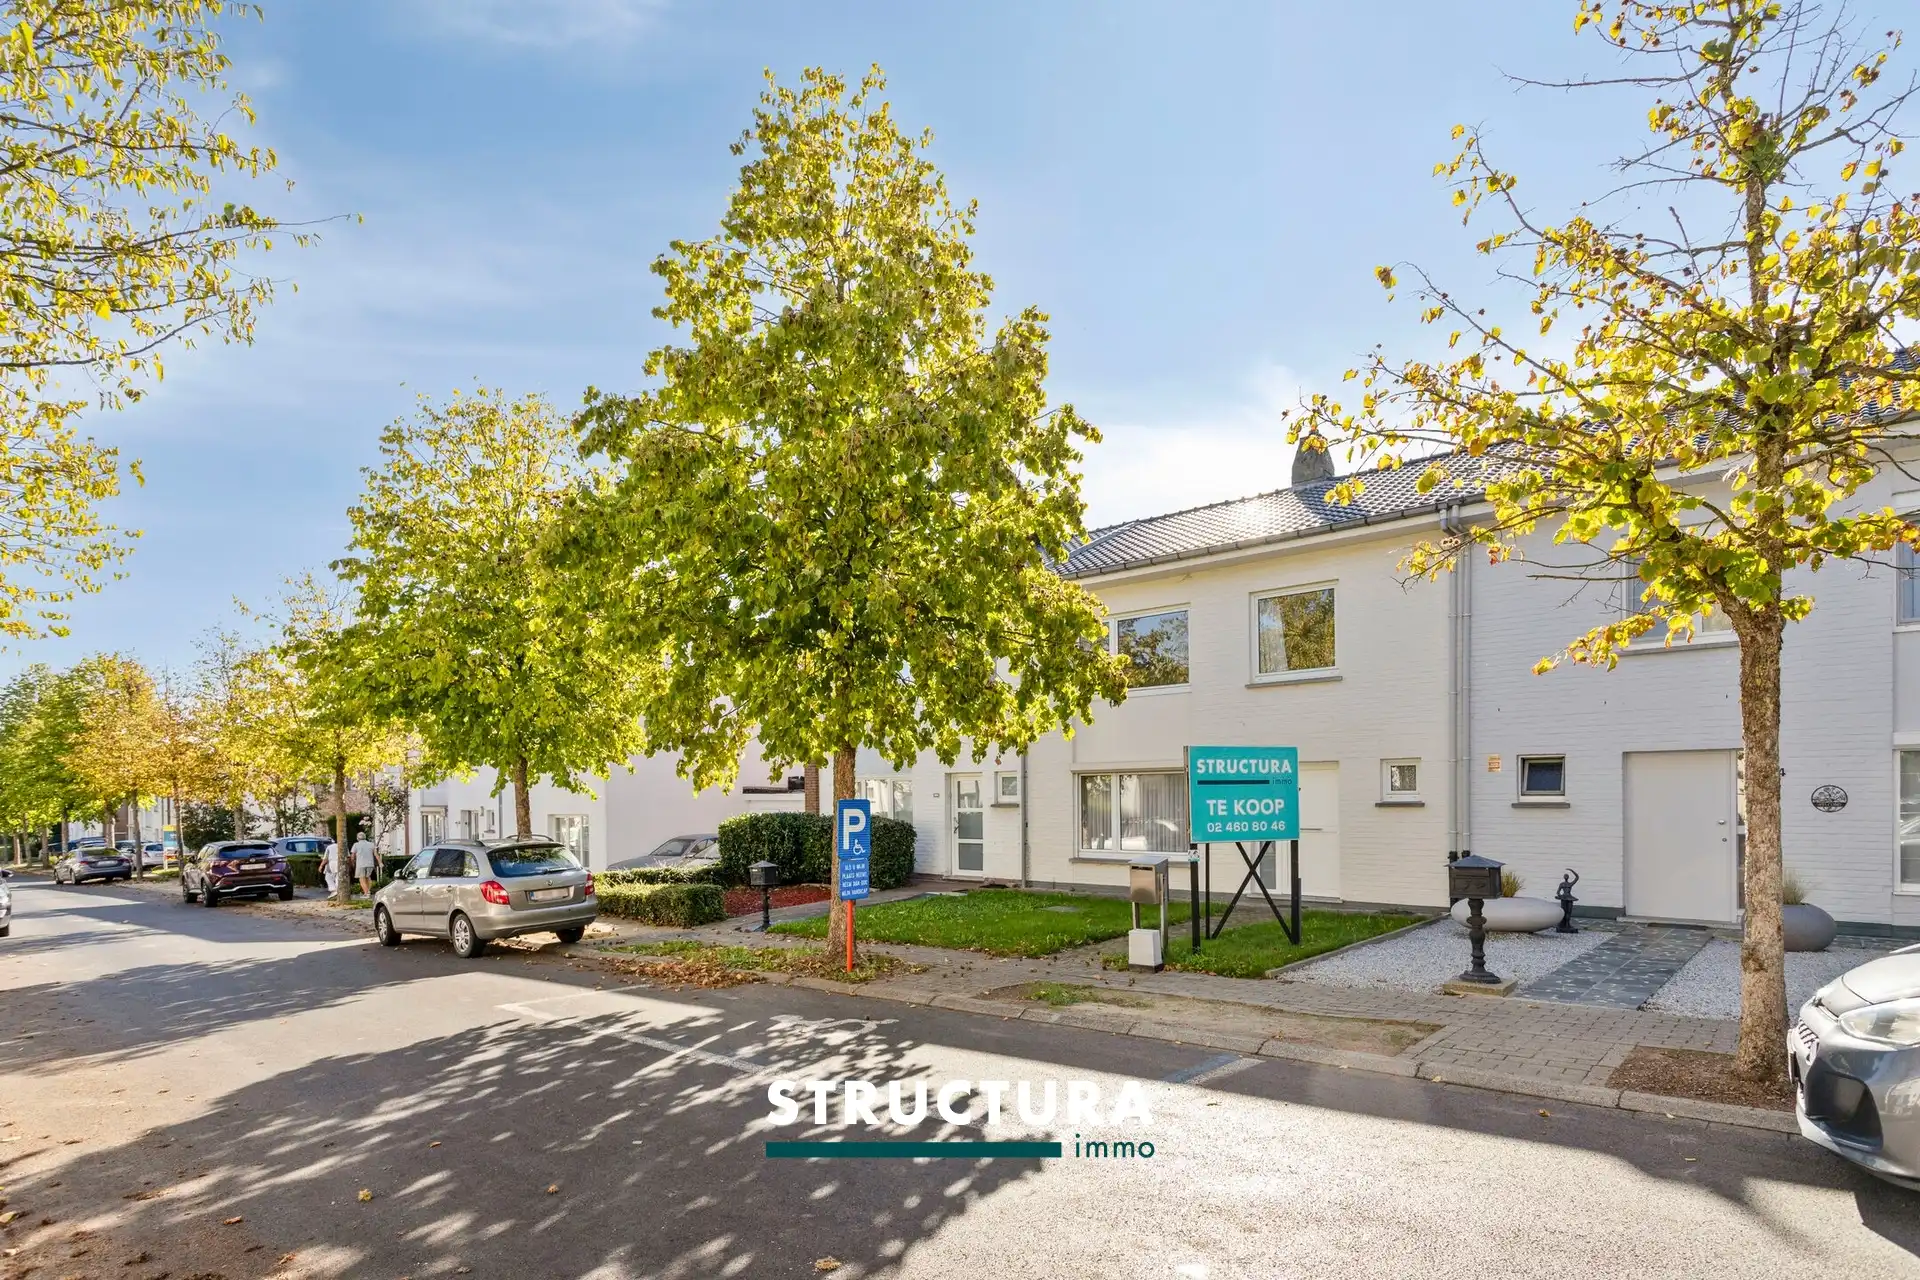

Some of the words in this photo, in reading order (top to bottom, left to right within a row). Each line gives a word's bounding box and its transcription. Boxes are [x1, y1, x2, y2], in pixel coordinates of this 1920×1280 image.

[1196, 758, 1292, 774] STRUCTURA
[1272, 776, 1293, 785] immo
[1206, 799, 1228, 816] TE
[1234, 798, 1285, 816] KOOP
[843, 808, 867, 850] P
[1207, 822, 1222, 833] 02
[1225, 821, 1249, 832] 460
[1252, 821, 1267, 832] 80
[1271, 820, 1286, 831] 46
